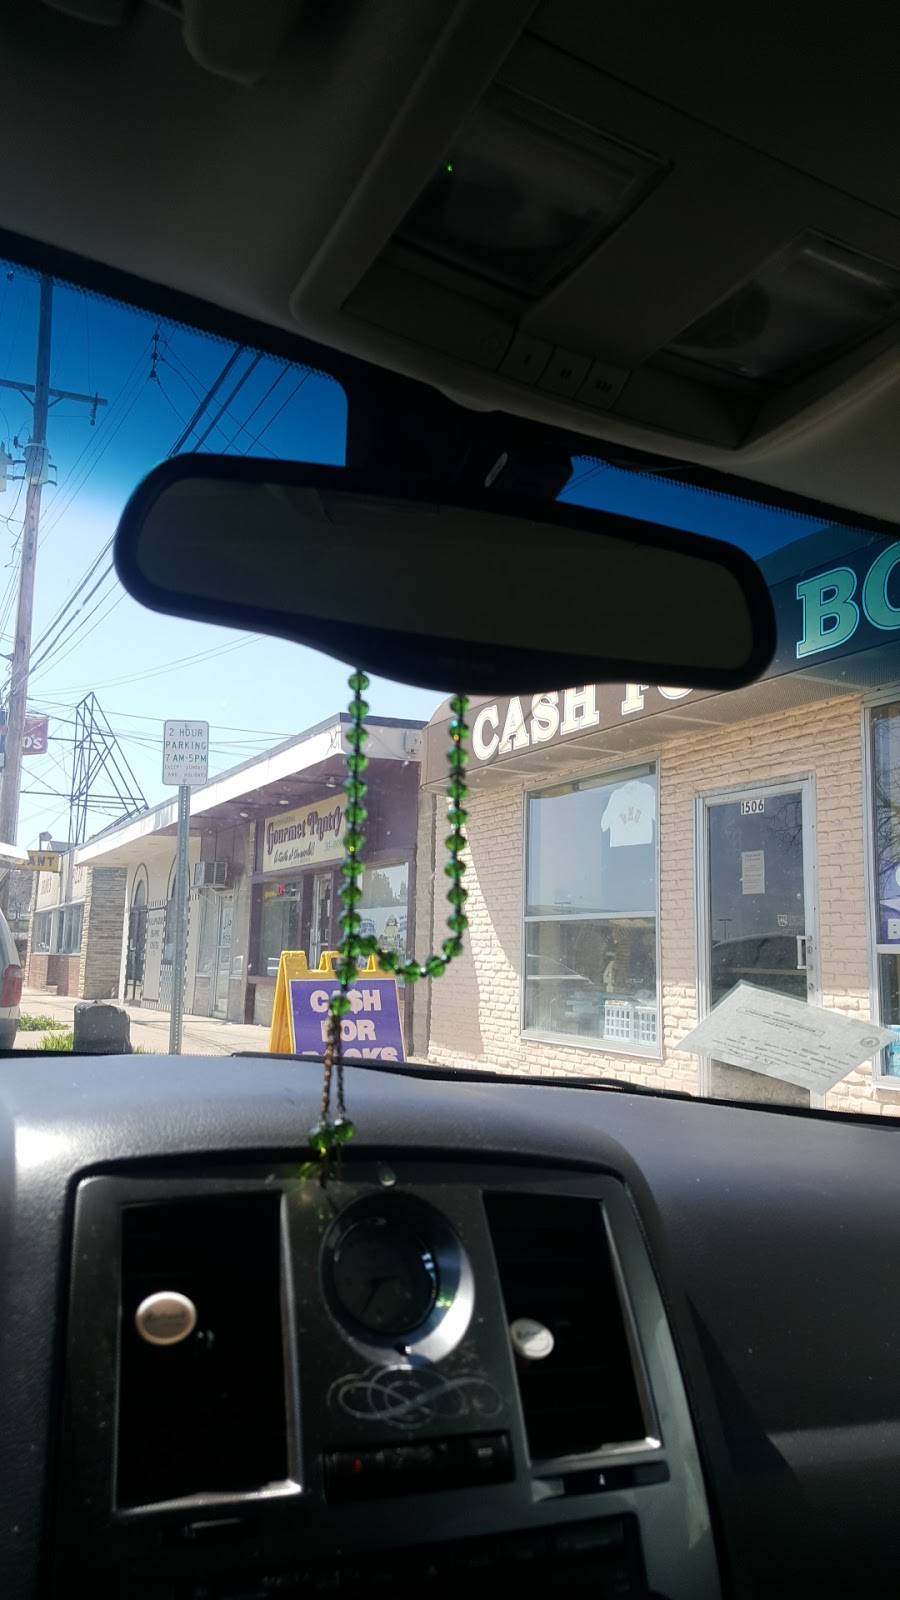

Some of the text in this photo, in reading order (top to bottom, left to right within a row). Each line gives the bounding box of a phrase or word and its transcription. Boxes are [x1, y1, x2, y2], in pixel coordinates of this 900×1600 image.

[169, 727, 203, 737] 2 HOUR
[472, 684, 600, 761] CASH
[165, 740, 207, 750] PARKING
[741, 800, 764, 814] 1506
[267, 819, 306, 856] Gourmet
[307, 805, 343, 842] Pantry
[309, 988, 382, 1016] C$H
